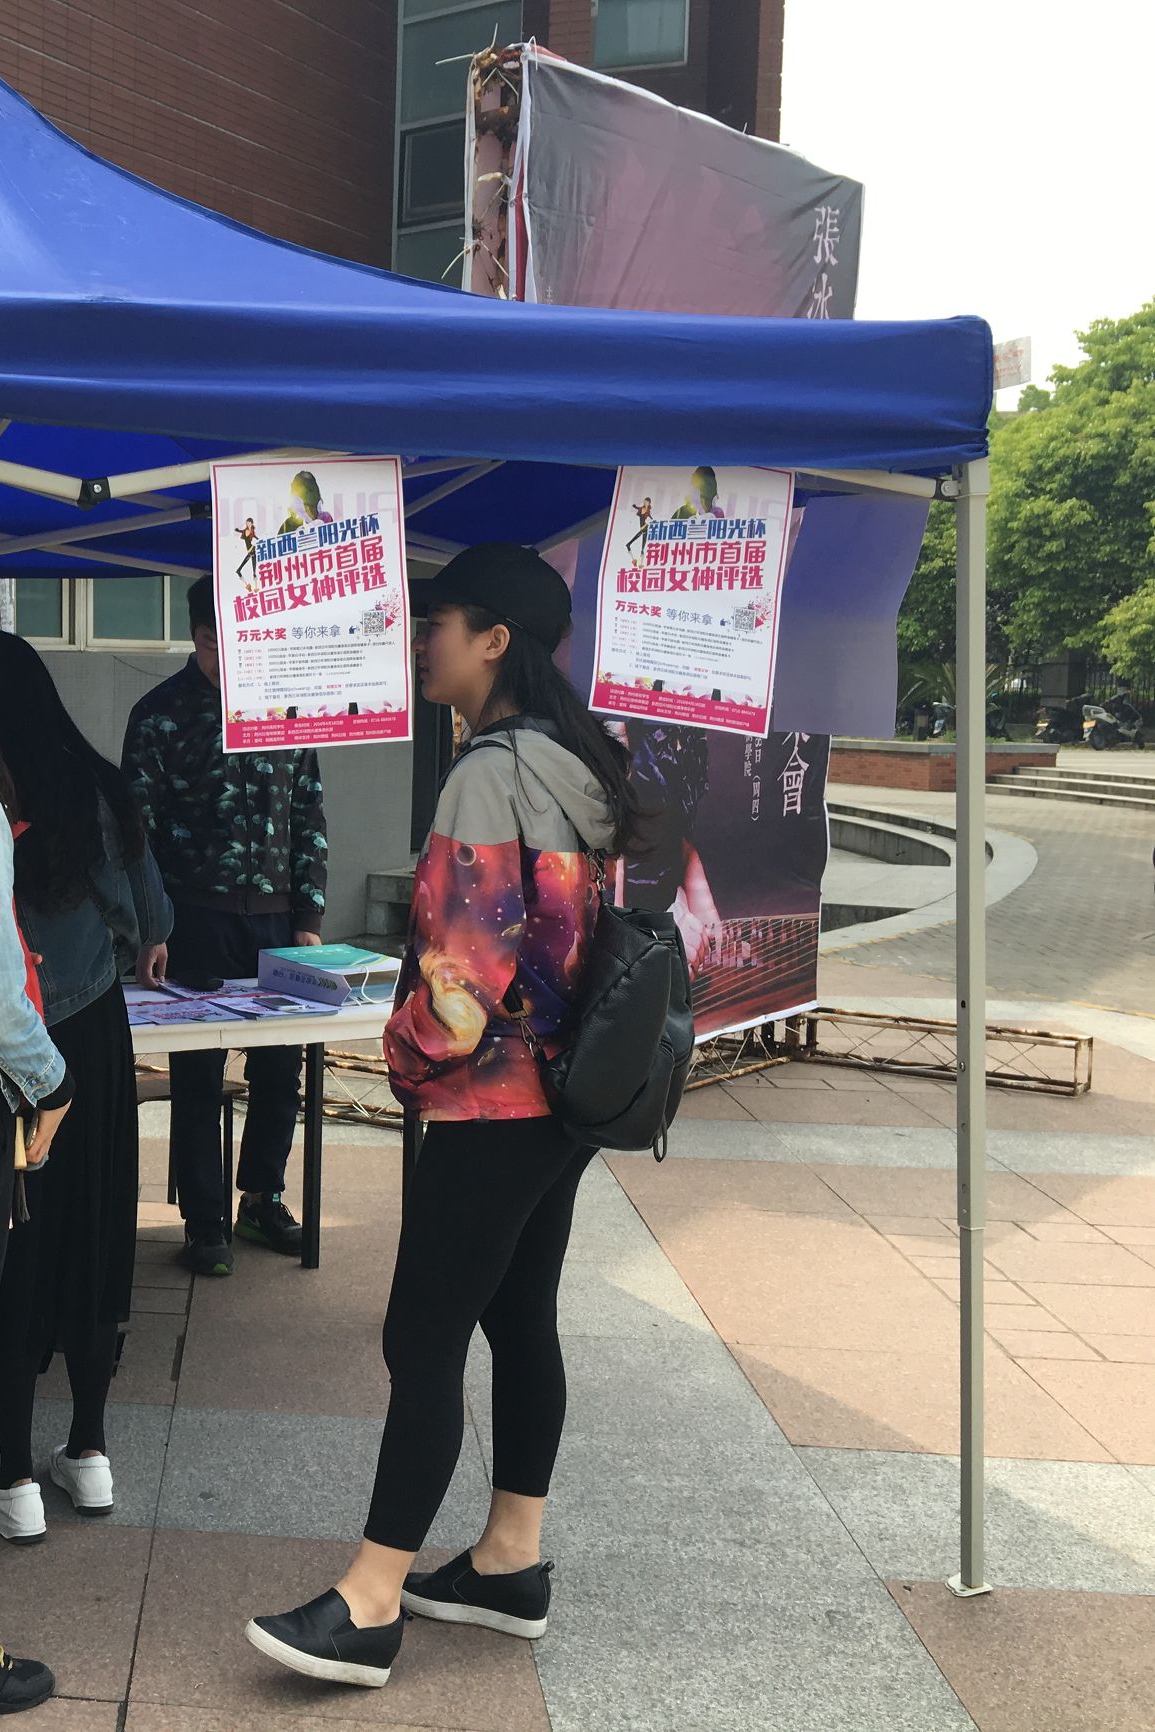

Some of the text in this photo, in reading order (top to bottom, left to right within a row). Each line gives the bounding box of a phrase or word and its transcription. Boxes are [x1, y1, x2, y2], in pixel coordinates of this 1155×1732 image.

[256, 513, 380, 562] 新西兰阳光杯
[648, 518, 767, 541] 新西兰阳光杯
[258, 535, 384, 588] 荆州市首届
[646, 540, 767, 566] 荆州市首届
[616, 565, 764, 593] 校园女神评选
[233, 563, 387, 623] 校园女神评选
[615, 600, 713, 626] 万元大奖 等你来拿
[237, 625, 341, 642] 万元大奖 等你来拿
